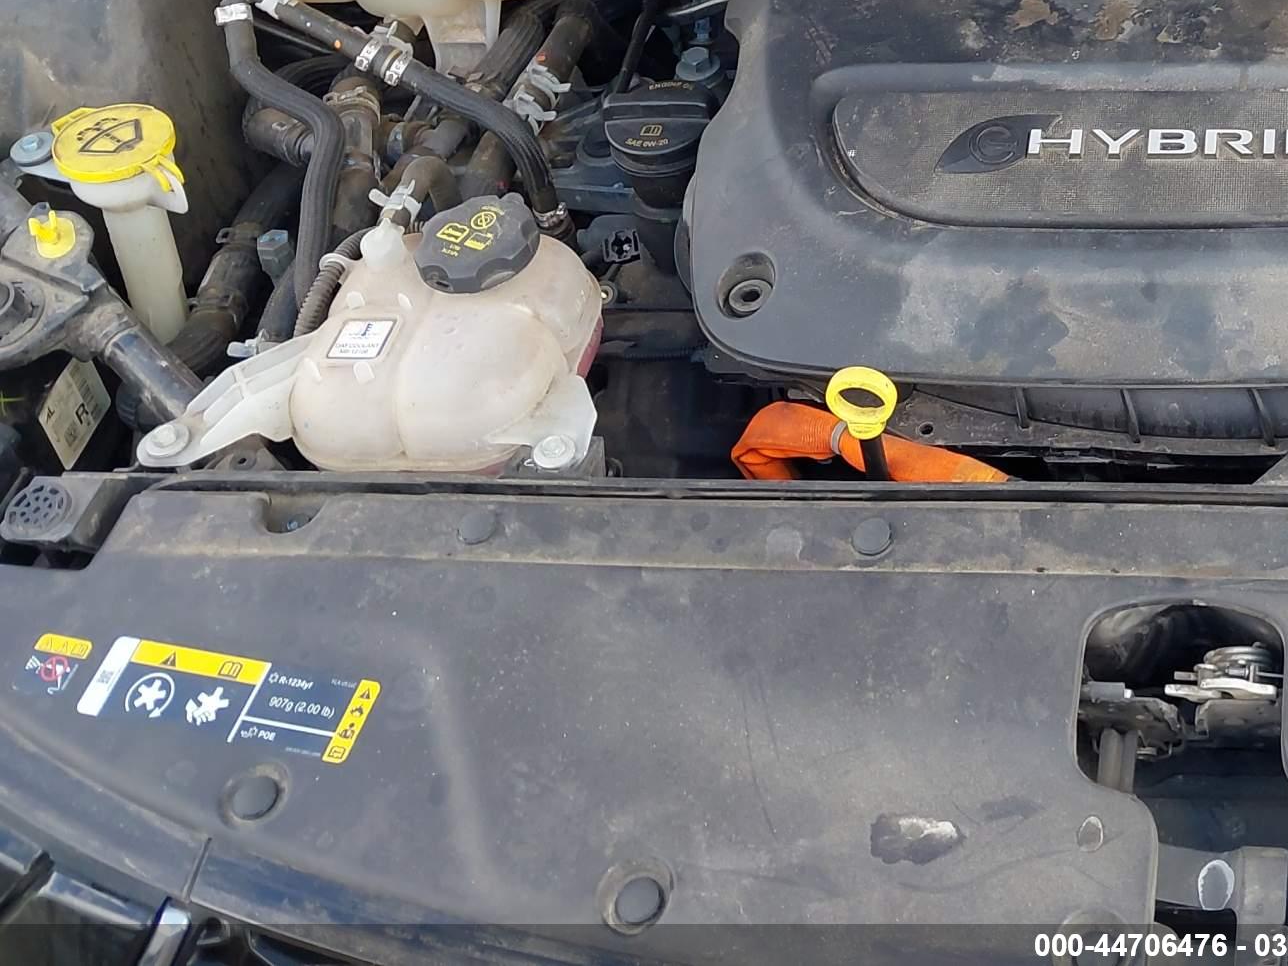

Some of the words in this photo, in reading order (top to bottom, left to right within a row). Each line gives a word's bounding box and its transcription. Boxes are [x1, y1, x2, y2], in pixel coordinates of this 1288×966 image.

[278, 676, 314, 691] R-1234yf
[269, 696, 294, 712] 907g
[294, 701, 321, 716] (2.00
[320, 707, 335, 720] lb)
